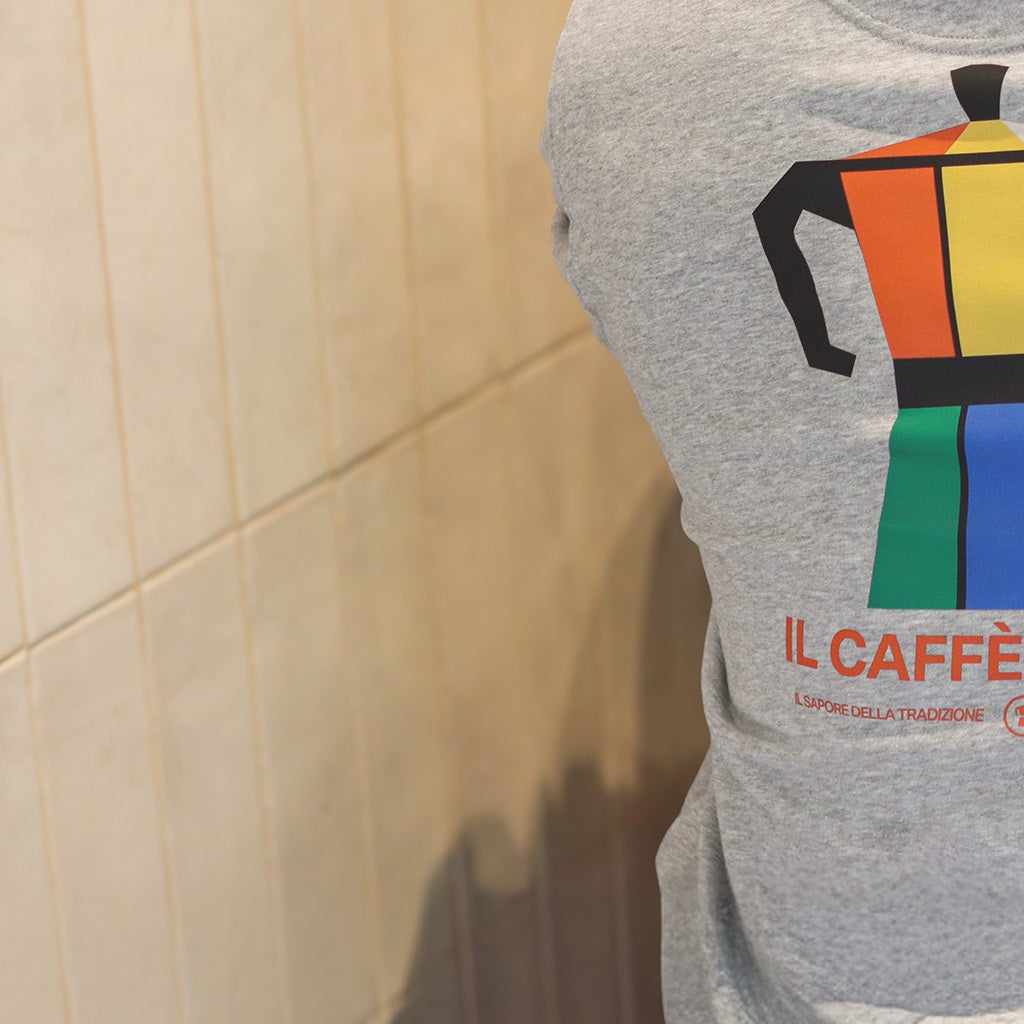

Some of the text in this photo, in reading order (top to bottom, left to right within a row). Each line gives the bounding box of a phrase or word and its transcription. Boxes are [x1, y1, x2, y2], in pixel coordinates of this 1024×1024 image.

[785, 616, 819, 670] IL
[829, 621, 1024, 683] CAFFÈ
[794, 692, 985, 722] IL SAPORE DELLA TRADIZIONE
